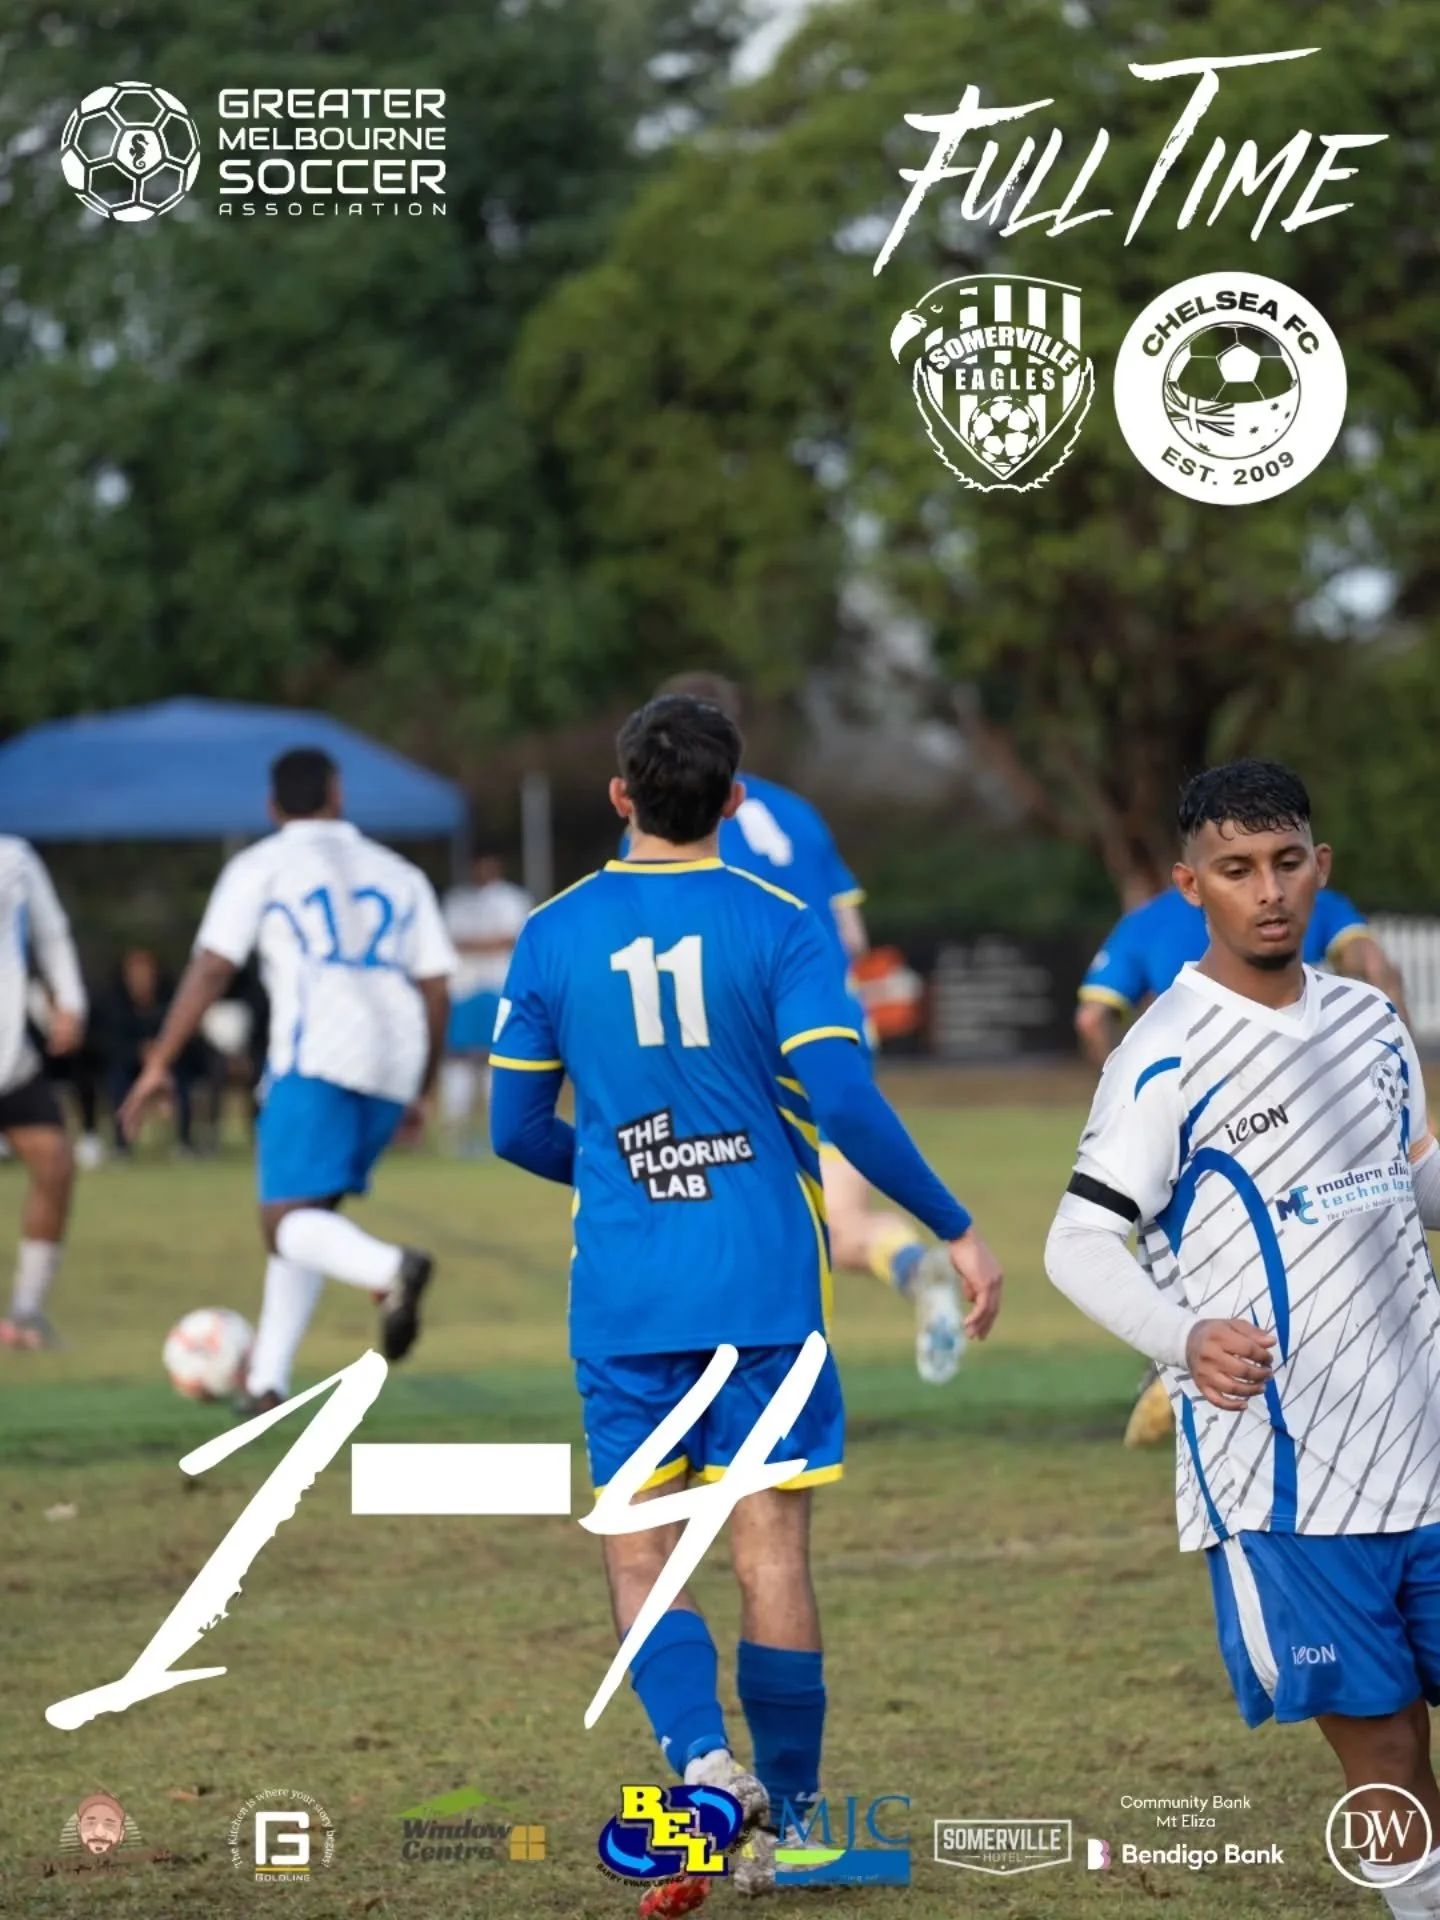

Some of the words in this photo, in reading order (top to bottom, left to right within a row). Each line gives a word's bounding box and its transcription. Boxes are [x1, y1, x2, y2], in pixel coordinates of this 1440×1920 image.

[303, 886, 396, 966] 12
[609, 935, 711, 1047] 11
[618, 1113, 670, 1151] THE
[629, 1136, 753, 1179] FLOORING
[649, 1174, 707, 1200] LAB
[1316, 1169, 1383, 1196] modern
